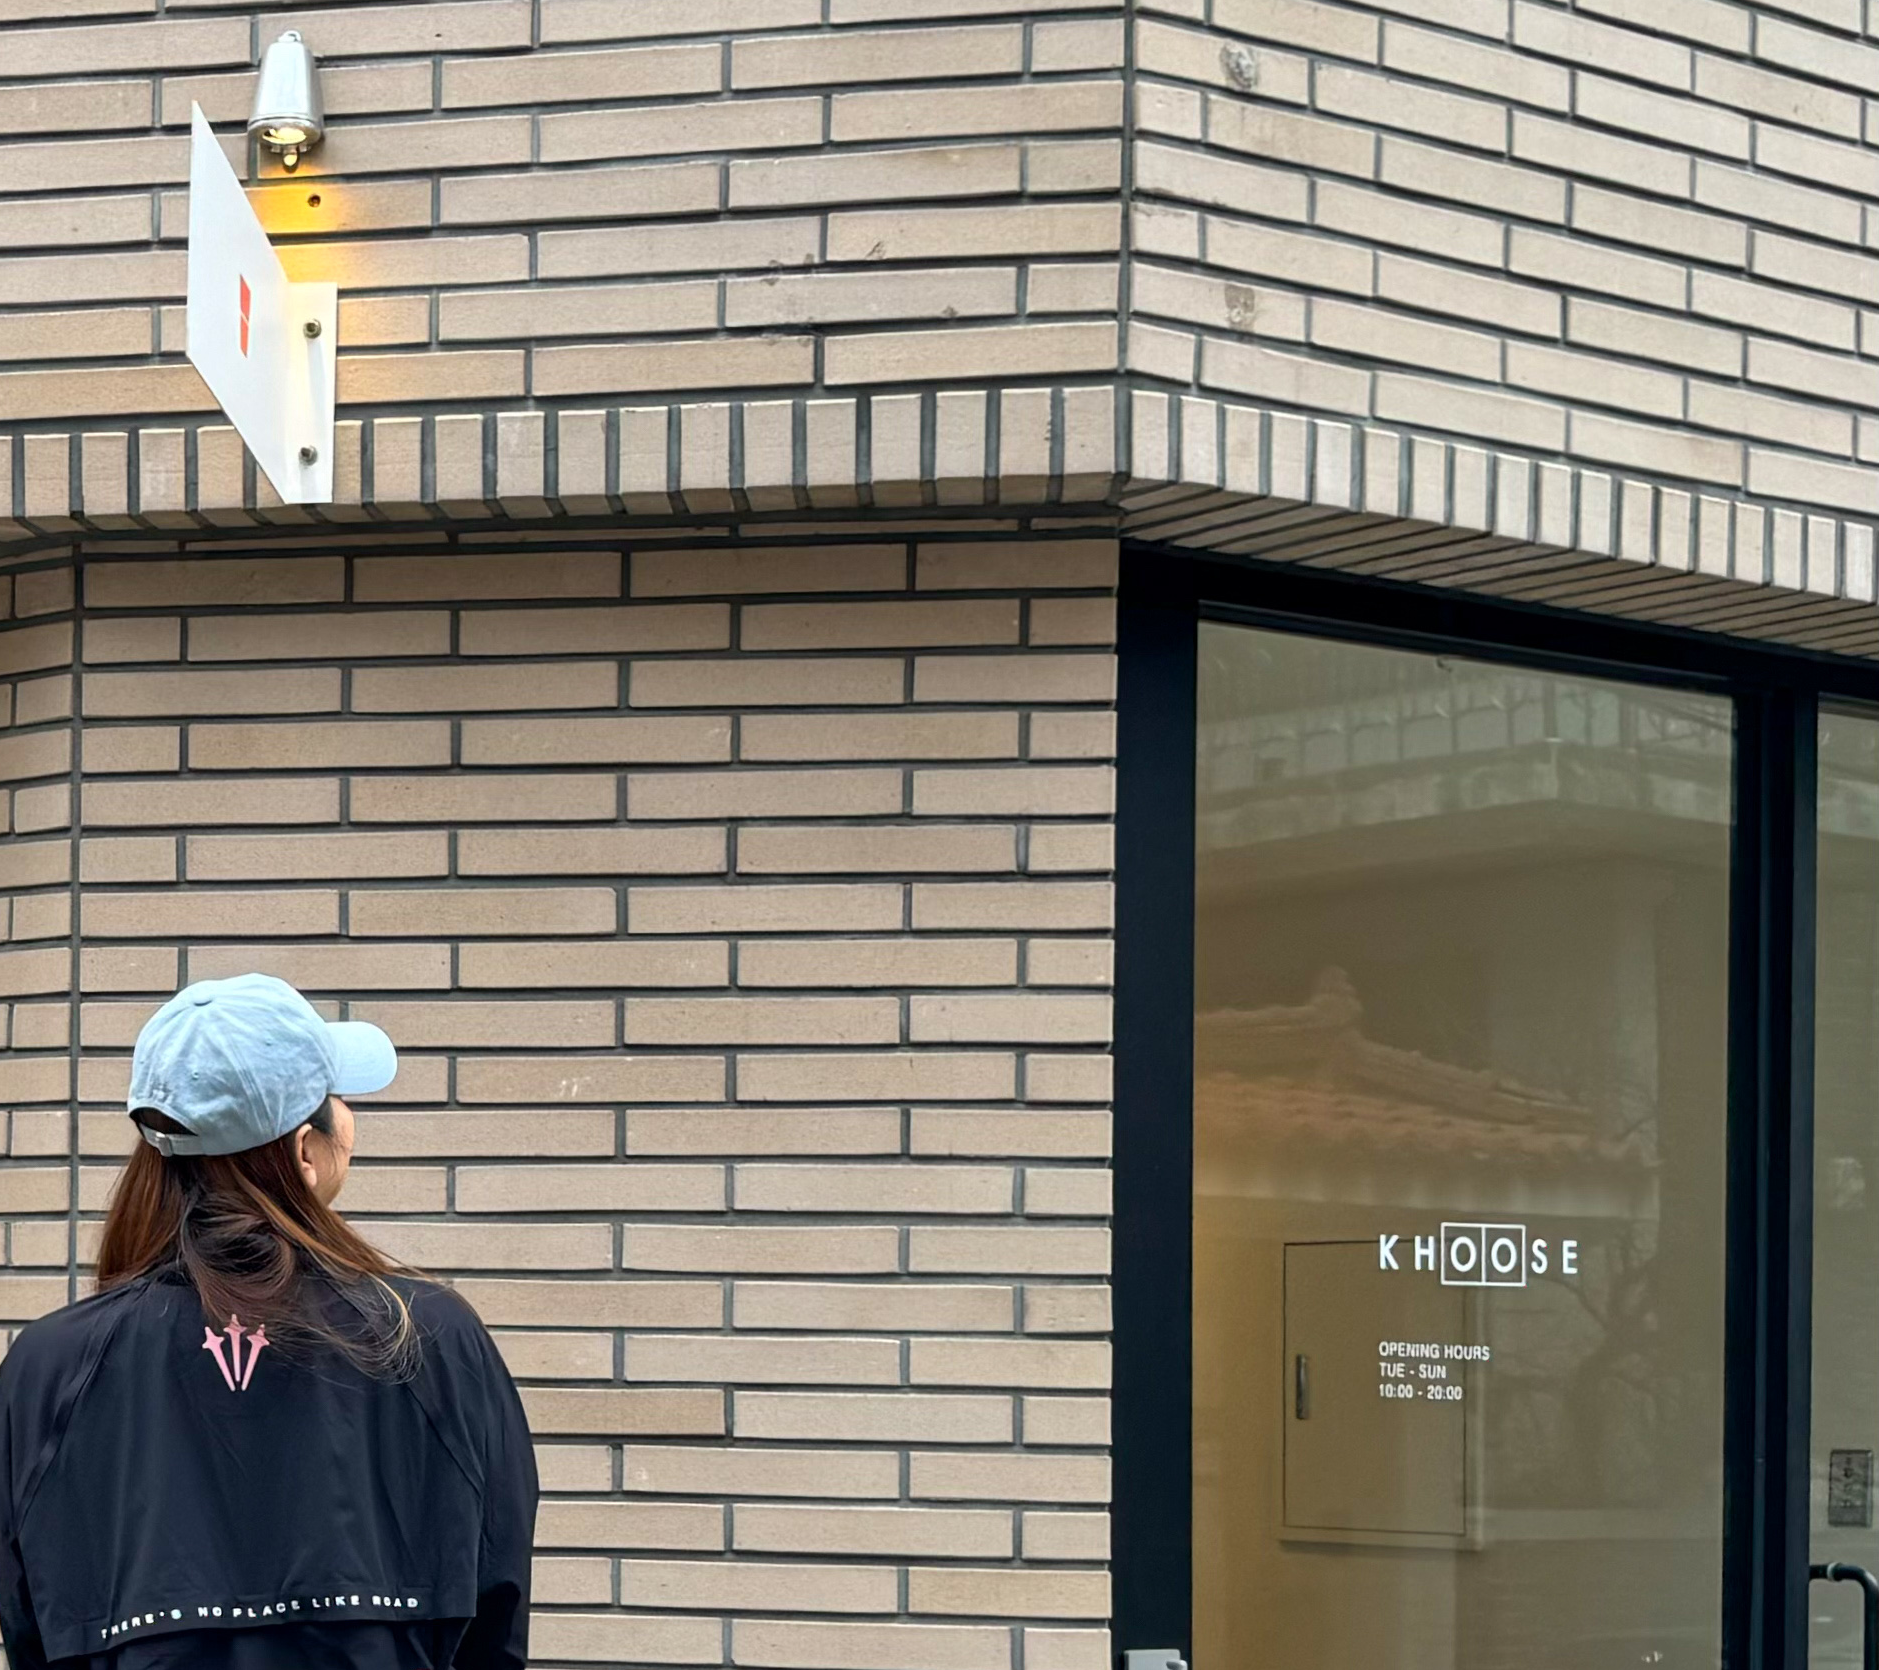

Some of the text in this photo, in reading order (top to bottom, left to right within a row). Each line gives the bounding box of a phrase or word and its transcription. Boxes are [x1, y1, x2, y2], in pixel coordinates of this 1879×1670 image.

[1379, 1226, 1579, 1282] KHOOSE
[1378, 1340, 1491, 1362] OPENING HOURS
[1378, 1361, 1407, 1379] TUE
[1417, 1362, 1448, 1381] SUN
[1378, 1382, 1416, 1400] 10:00
[1426, 1383, 1463, 1401] 20:00
[100, 1608, 182, 1639] THERE'S
[197, 1606, 223, 1618] NO
[232, 1600, 301, 1618] PLACE
[311, 1594, 360, 1608] LIKE
